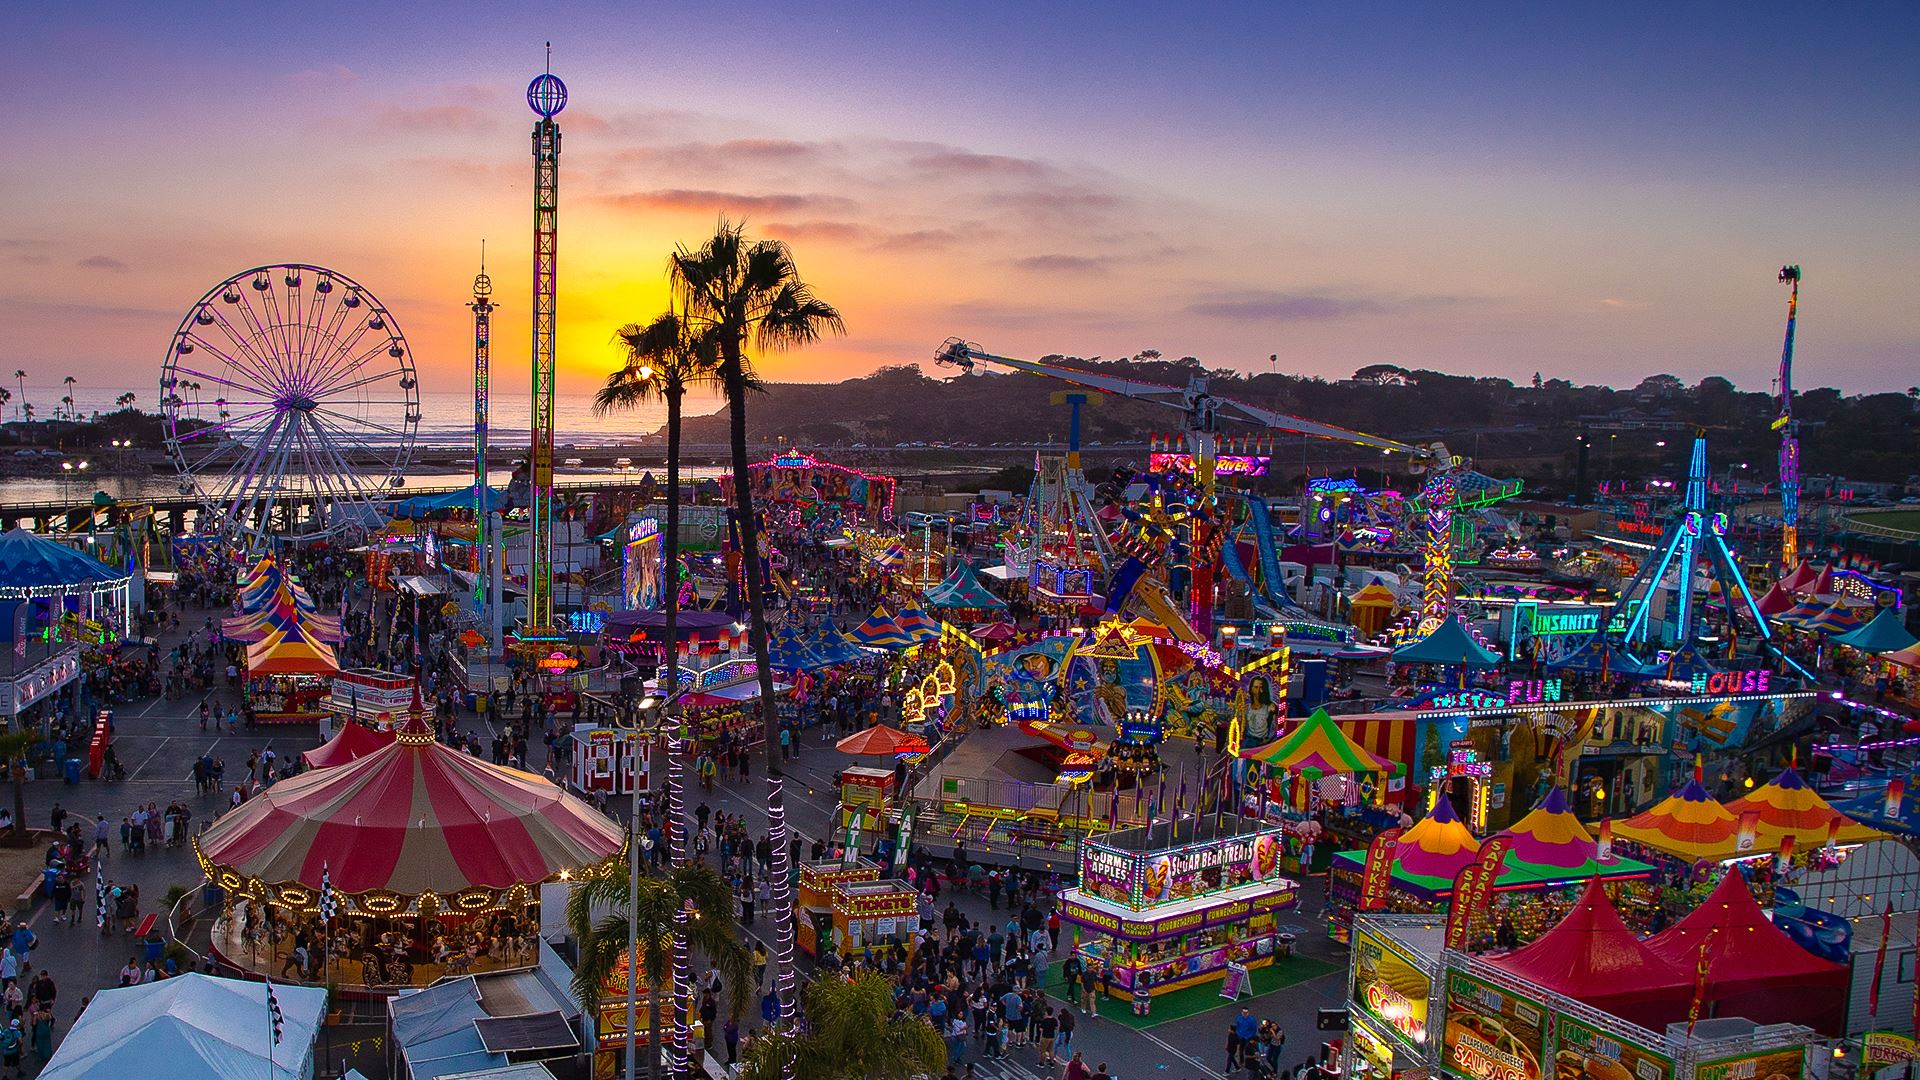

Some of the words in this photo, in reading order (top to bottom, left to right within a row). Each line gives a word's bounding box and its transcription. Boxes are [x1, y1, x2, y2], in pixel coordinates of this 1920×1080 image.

[777, 458, 811, 467] MAGNUM
[1215, 459, 1249, 472] RIVER
[1537, 614, 1599, 631] INSANITY
[1433, 693, 1505, 708] TWISTED
[1510, 679, 1562, 703] FUN
[1692, 670, 1772, 694] HOUSE
[844, 813, 861, 863] ATM
[895, 814, 912, 865] ATM
[1087, 848, 1134, 872] GOURMET
[1091, 861, 1128, 882] APPLES
[1171, 852, 1200, 877] SUGAR
[1201, 849, 1222, 868] BEAR
[1224, 843, 1252, 864] TREATS
[1364, 836, 1387, 908] TURKEY
[854, 896, 911, 912] TICKETS
[1208, 907, 1230, 920] FUNNEL
[1232, 902, 1249, 915] CAKES
[1449, 869, 1474, 948] SAUSAGE
[1067, 905, 1091, 921] CORN
[1093, 913, 1118, 930] DOGS
[1125, 928, 1151, 936] DRINKS
[1380, 981, 1412, 1013] ROASTED
[1451, 974, 1478, 999] FARM
[1480, 986, 1504, 1012] FAIR
[1561, 1020, 1593, 1050] FARM
[1595, 1034, 1621, 1063] FAIR
[1493, 1048, 1501, 1061] &
[1501, 1051, 1525, 1072] CHEESE
[1869, 1046, 1915, 1062] TURKEY
[1732, 1058, 1757, 1080] FAIR
